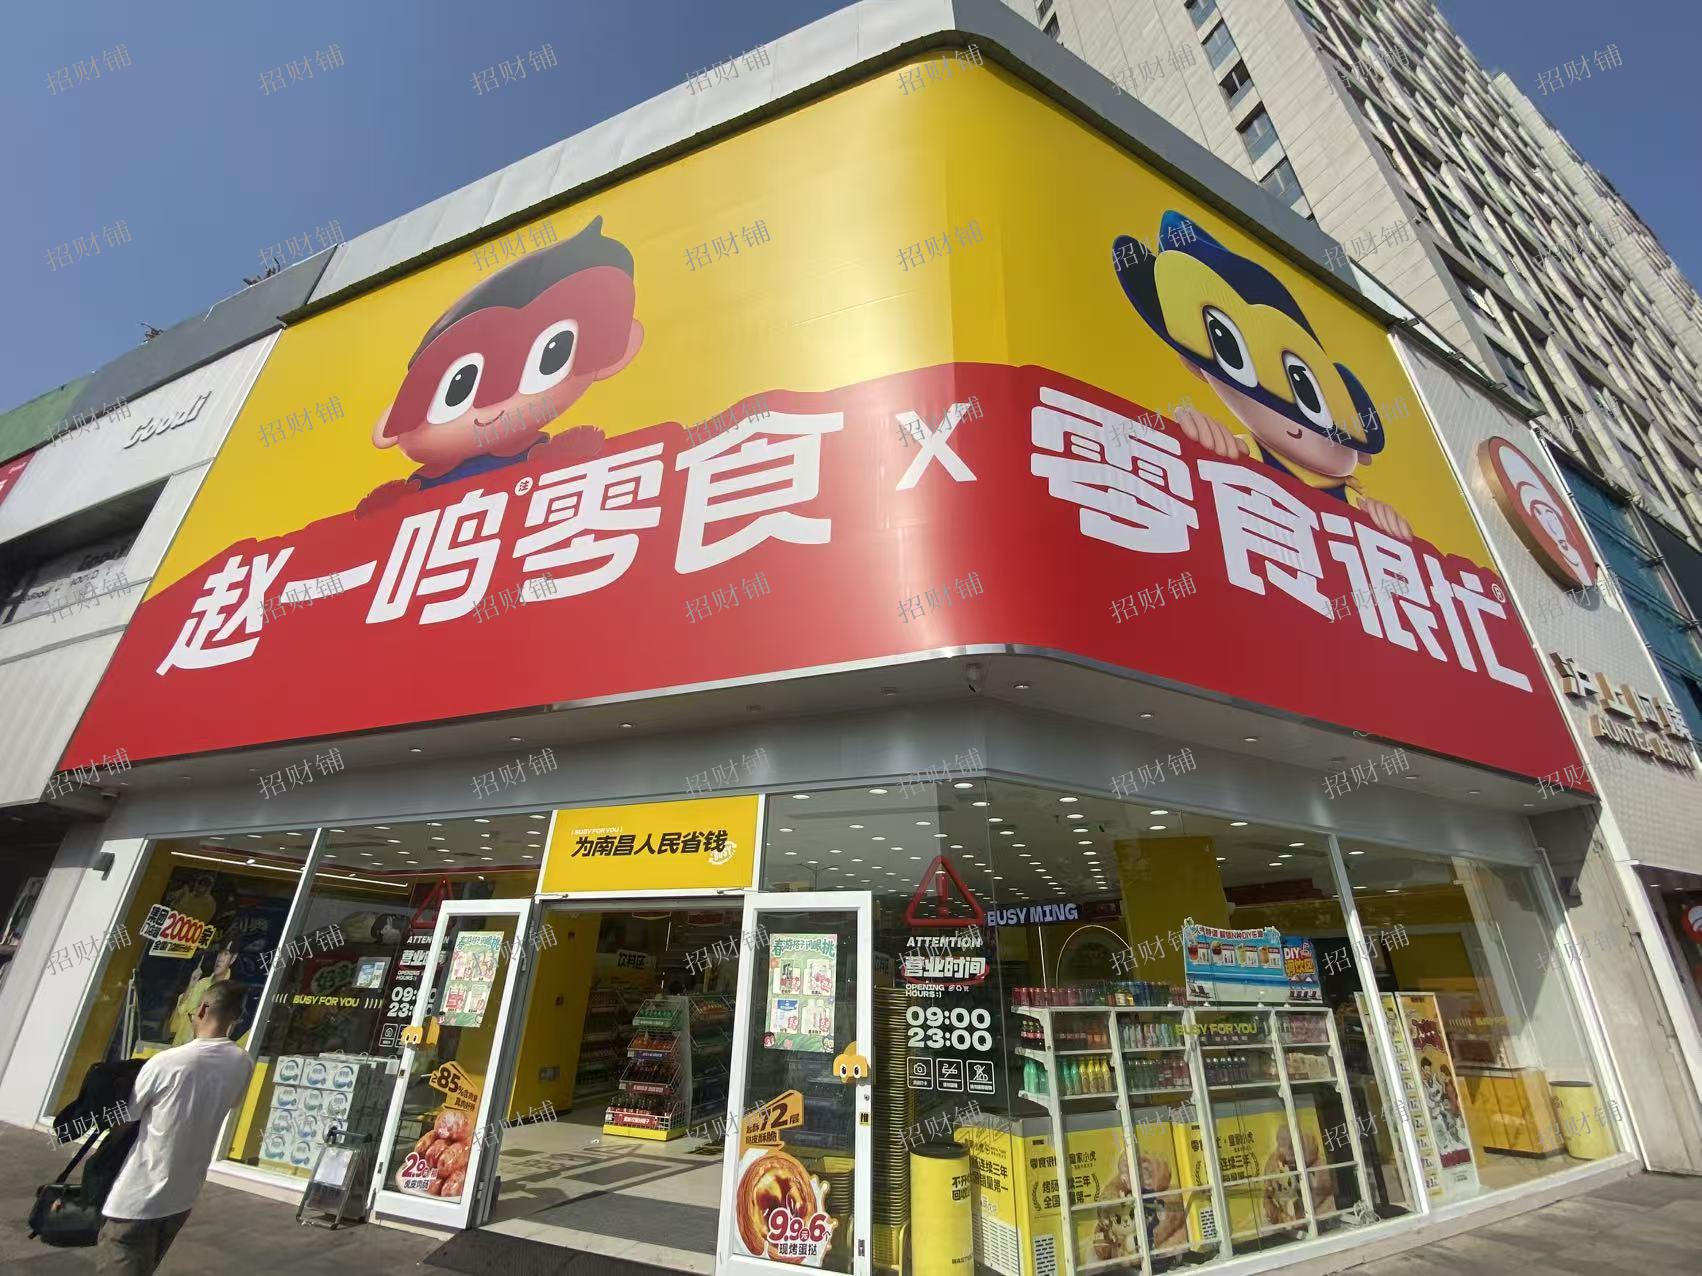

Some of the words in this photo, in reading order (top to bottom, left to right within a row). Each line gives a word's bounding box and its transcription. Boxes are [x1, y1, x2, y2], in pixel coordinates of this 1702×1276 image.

[156, 411, 844, 676] 赵一鸣零食
[1030, 386, 1534, 693] 零食很忙
[571, 830, 729, 857] 为南昌人民省钱
[987, 908, 1027, 927] BUSY
[1030, 903, 1079, 923] MING
[906, 936, 982, 948] ATTENTION
[1283, 947, 1300, 960] DIY
[904, 957, 986, 979] 营业时间
[292, 995, 317, 1005] BUSY
[318, 996, 338, 1006] FOR
[339, 997, 360, 1007] YOU
[905, 1005, 991, 1029] 09:00
[907, 1027, 993, 1051] 23:00
[1174, 1024, 1207, 1036] BUSY
[1209, 1024, 1234, 1035] FOR
[1235, 1023, 1258, 1034] YOU
